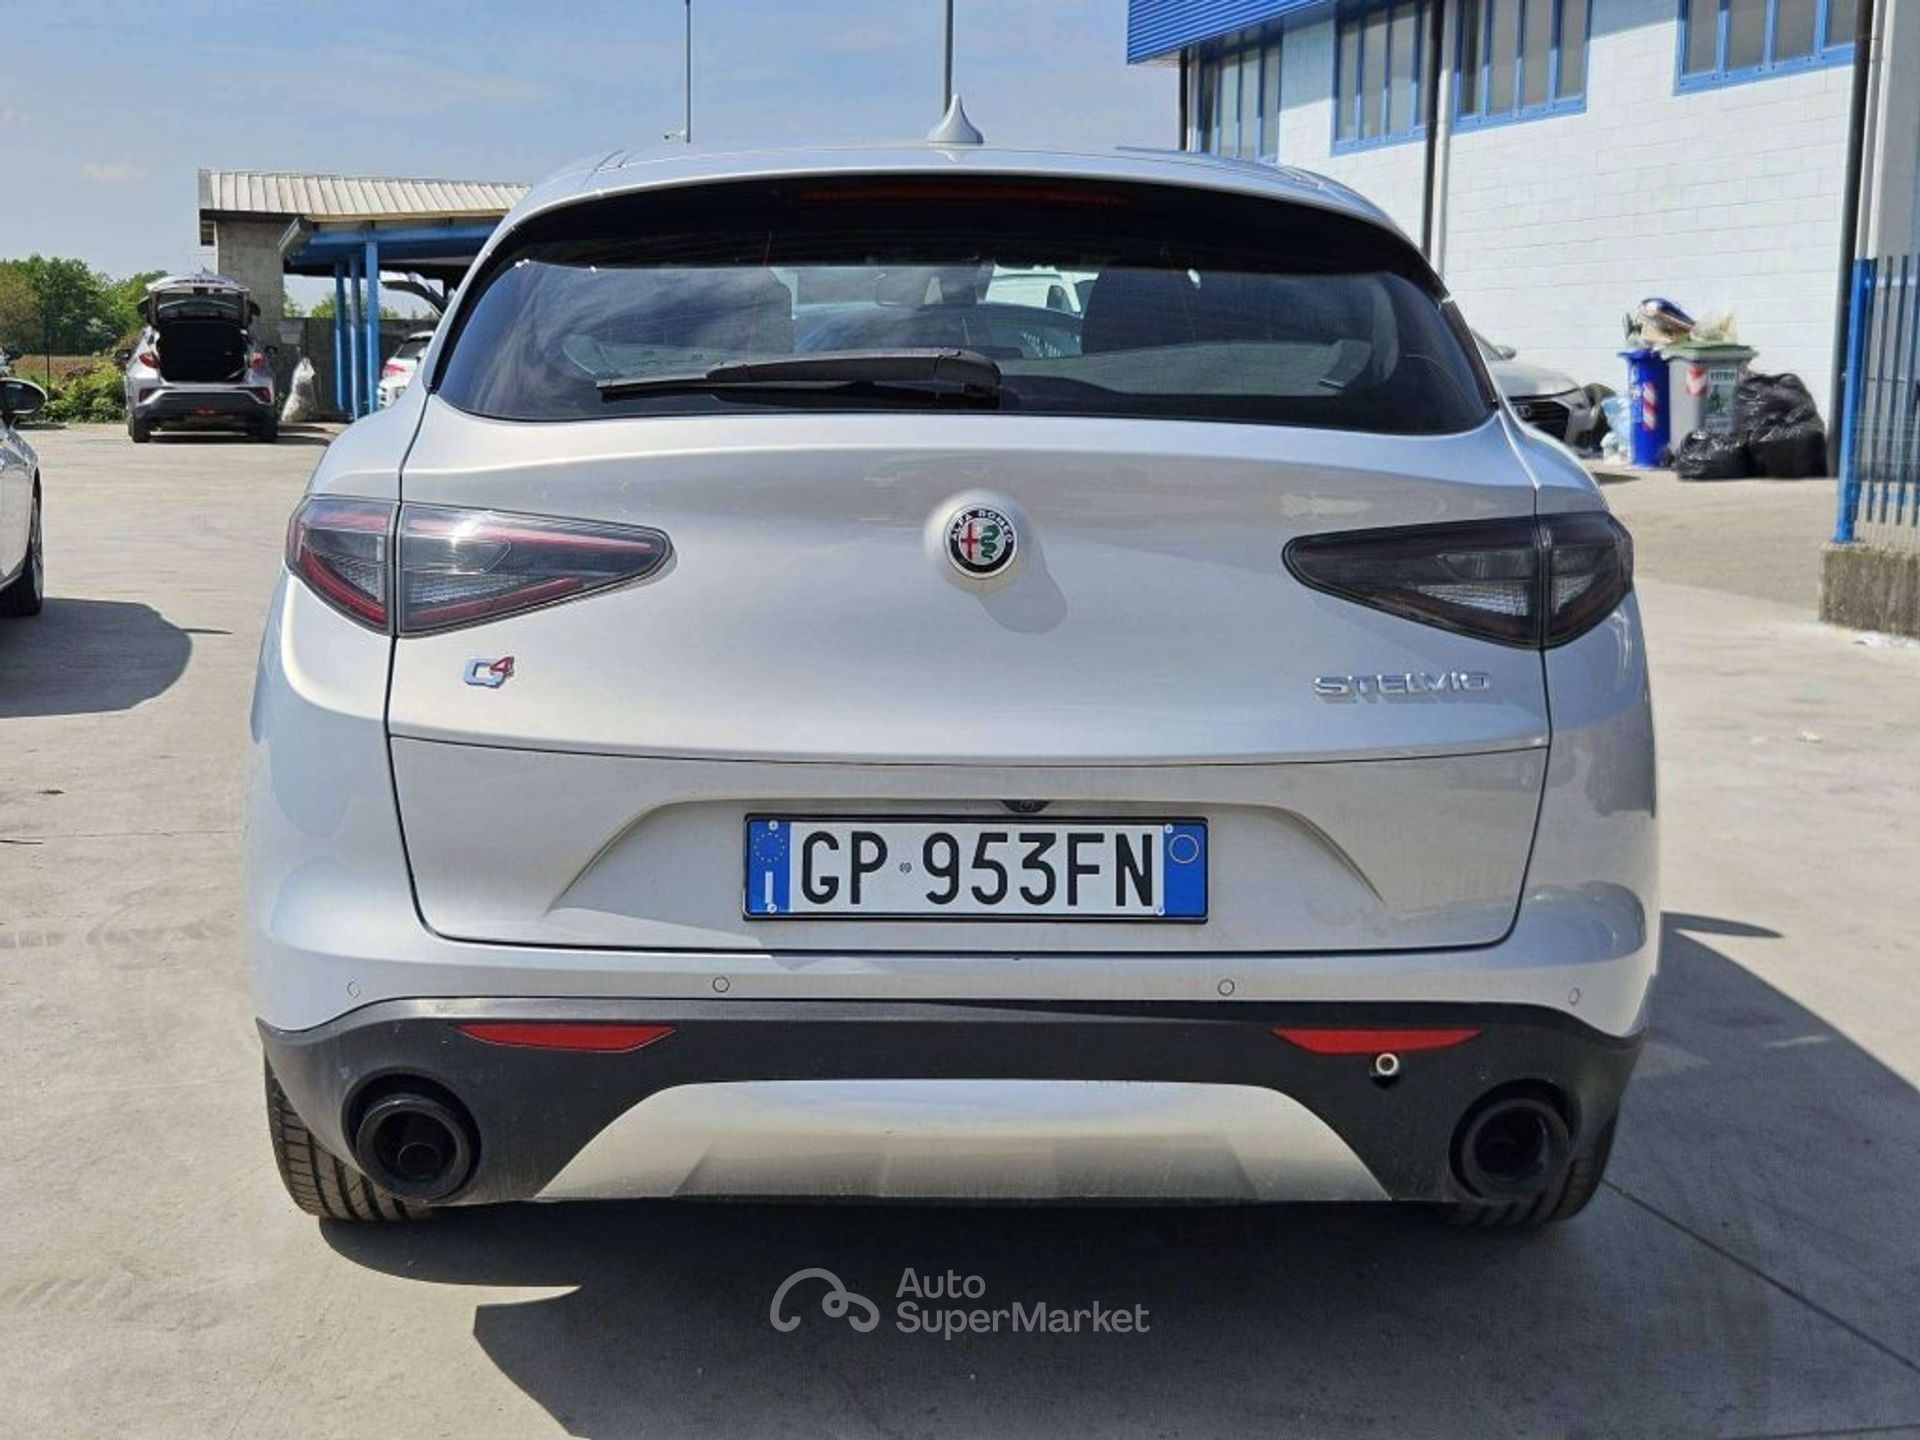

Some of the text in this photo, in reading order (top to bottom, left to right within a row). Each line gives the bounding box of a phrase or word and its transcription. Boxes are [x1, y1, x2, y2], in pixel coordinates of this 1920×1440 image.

[1314, 671, 1491, 696] STELVIO
[801, 830, 1153, 907] GP 953FN
